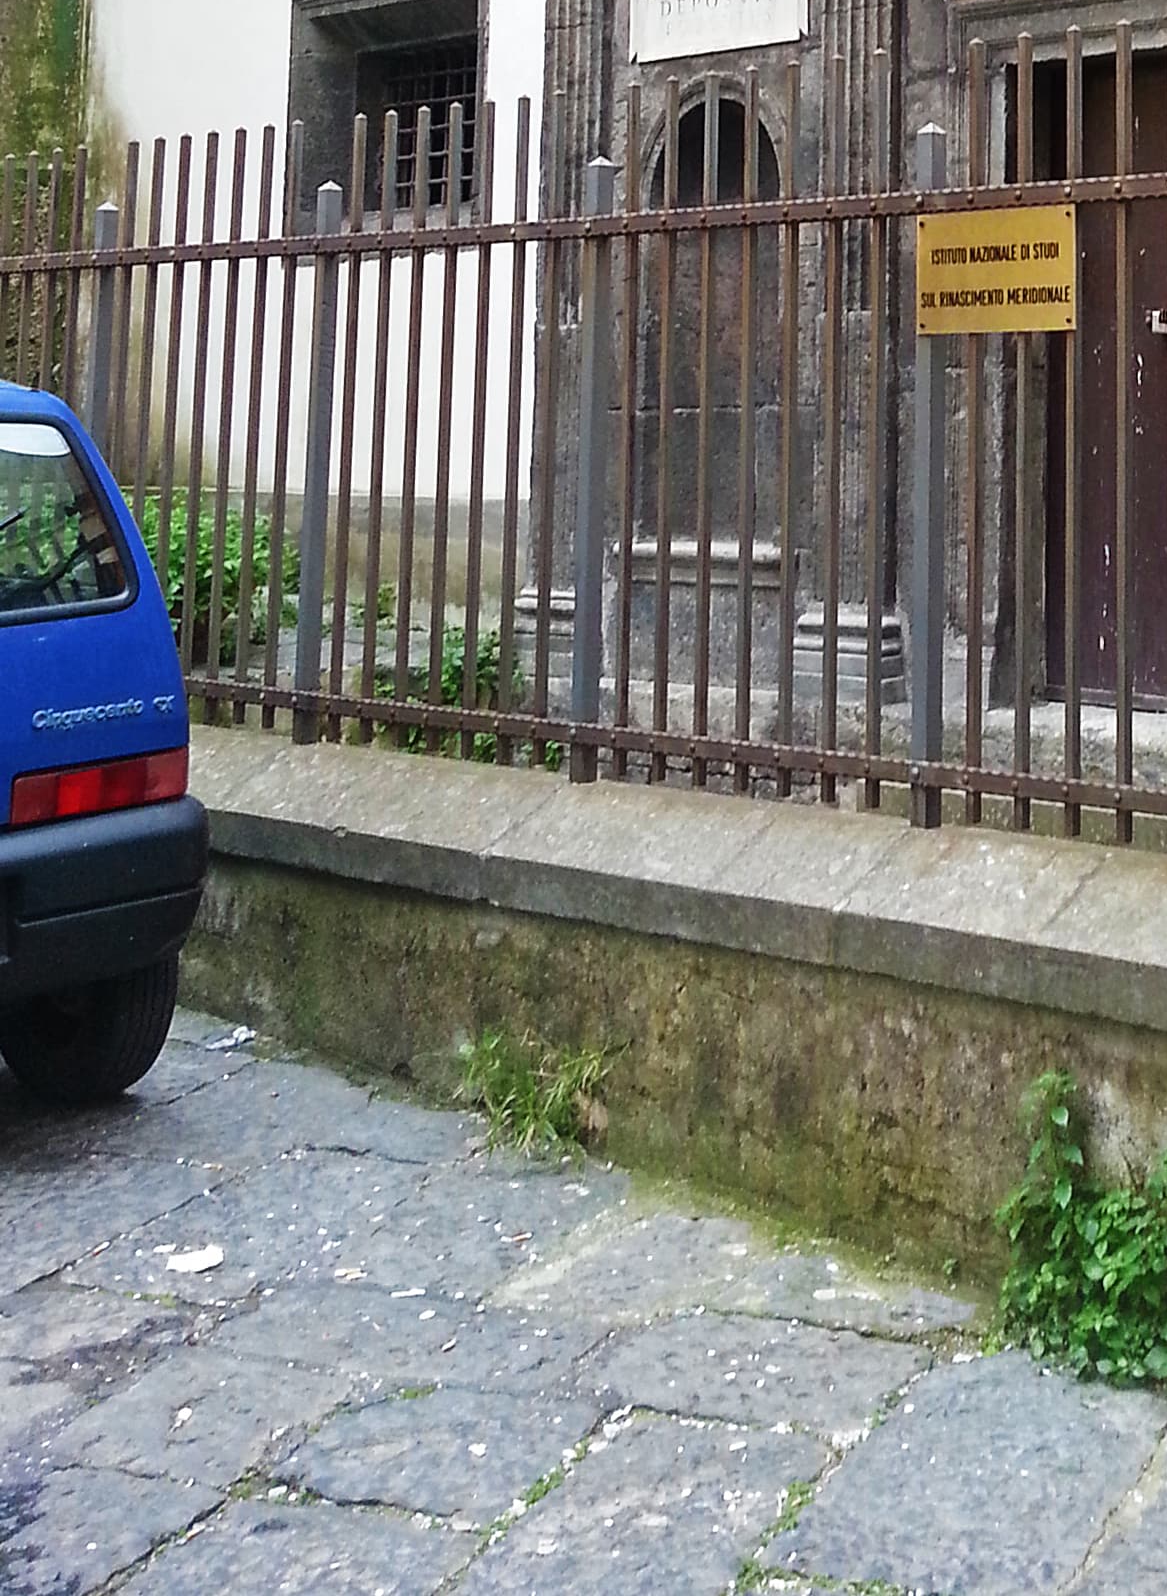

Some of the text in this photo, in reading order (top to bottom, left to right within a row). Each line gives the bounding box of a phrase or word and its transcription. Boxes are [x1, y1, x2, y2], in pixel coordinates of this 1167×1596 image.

[931, 241, 1060, 265] ISTITUTO NAZIONALE DI STUDI
[920, 285, 1071, 308] SUL RINASCIMENTO MERIDIONALE
[32, 698, 144, 729] Cinquecento
